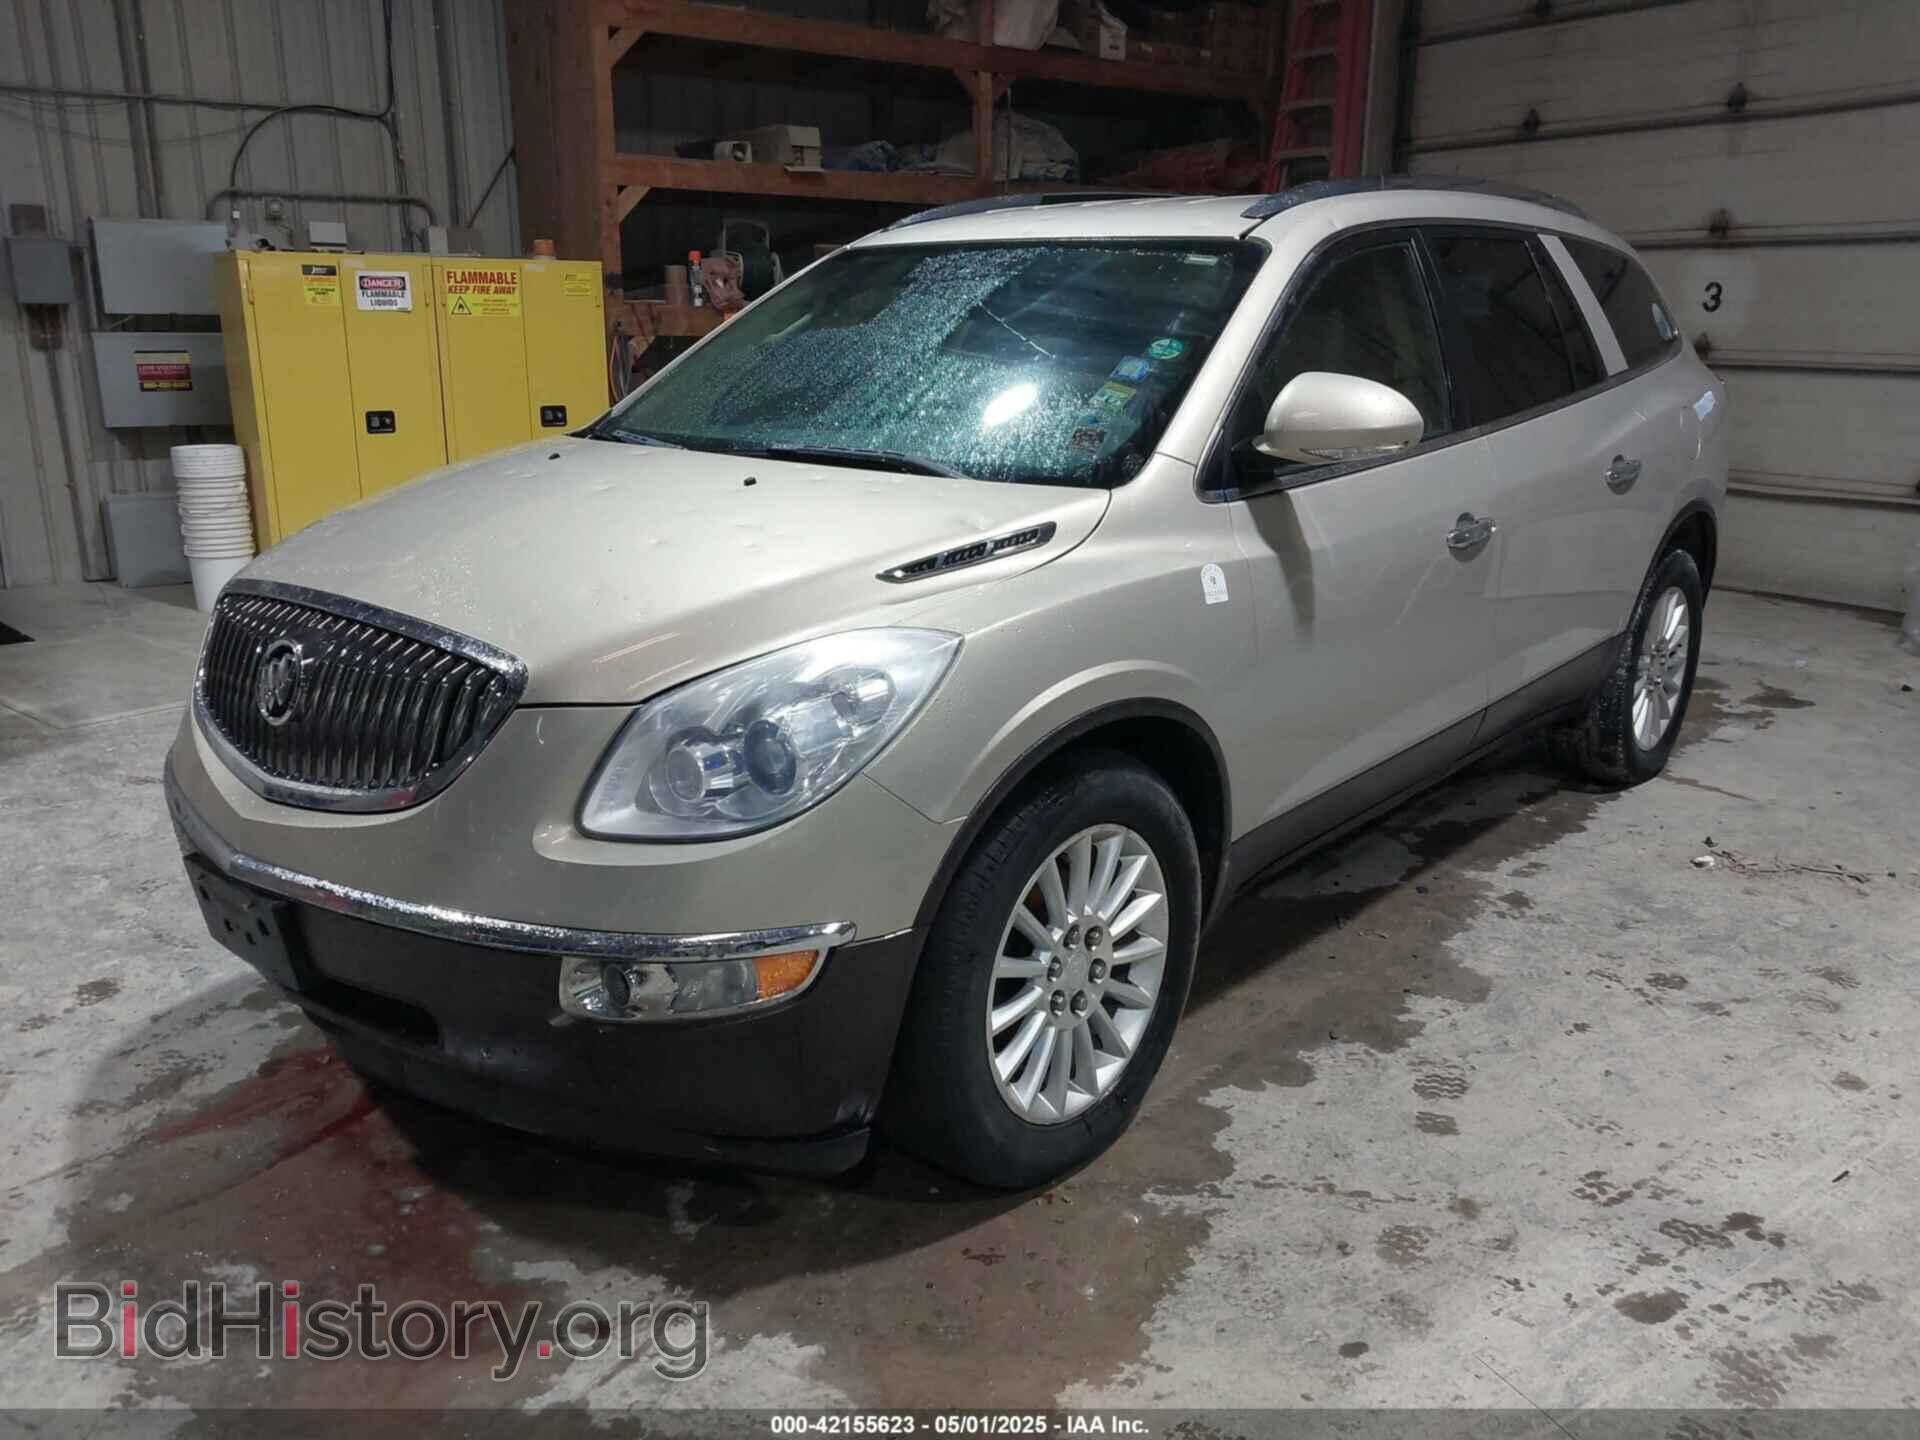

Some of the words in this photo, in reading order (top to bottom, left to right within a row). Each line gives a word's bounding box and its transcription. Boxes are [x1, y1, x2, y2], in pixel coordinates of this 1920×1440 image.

[447, 271, 517, 284] FLAMMABLE
[362, 278, 402, 289] DANGER
[361, 289, 405, 298] FLAMMABLE
[448, 285, 470, 295] KEEP
[472, 285, 491, 295] FIRE
[492, 286, 516, 295] AWAY
[1702, 281, 1722, 313] 3
[370, 299, 399, 307] LIQUIDS
